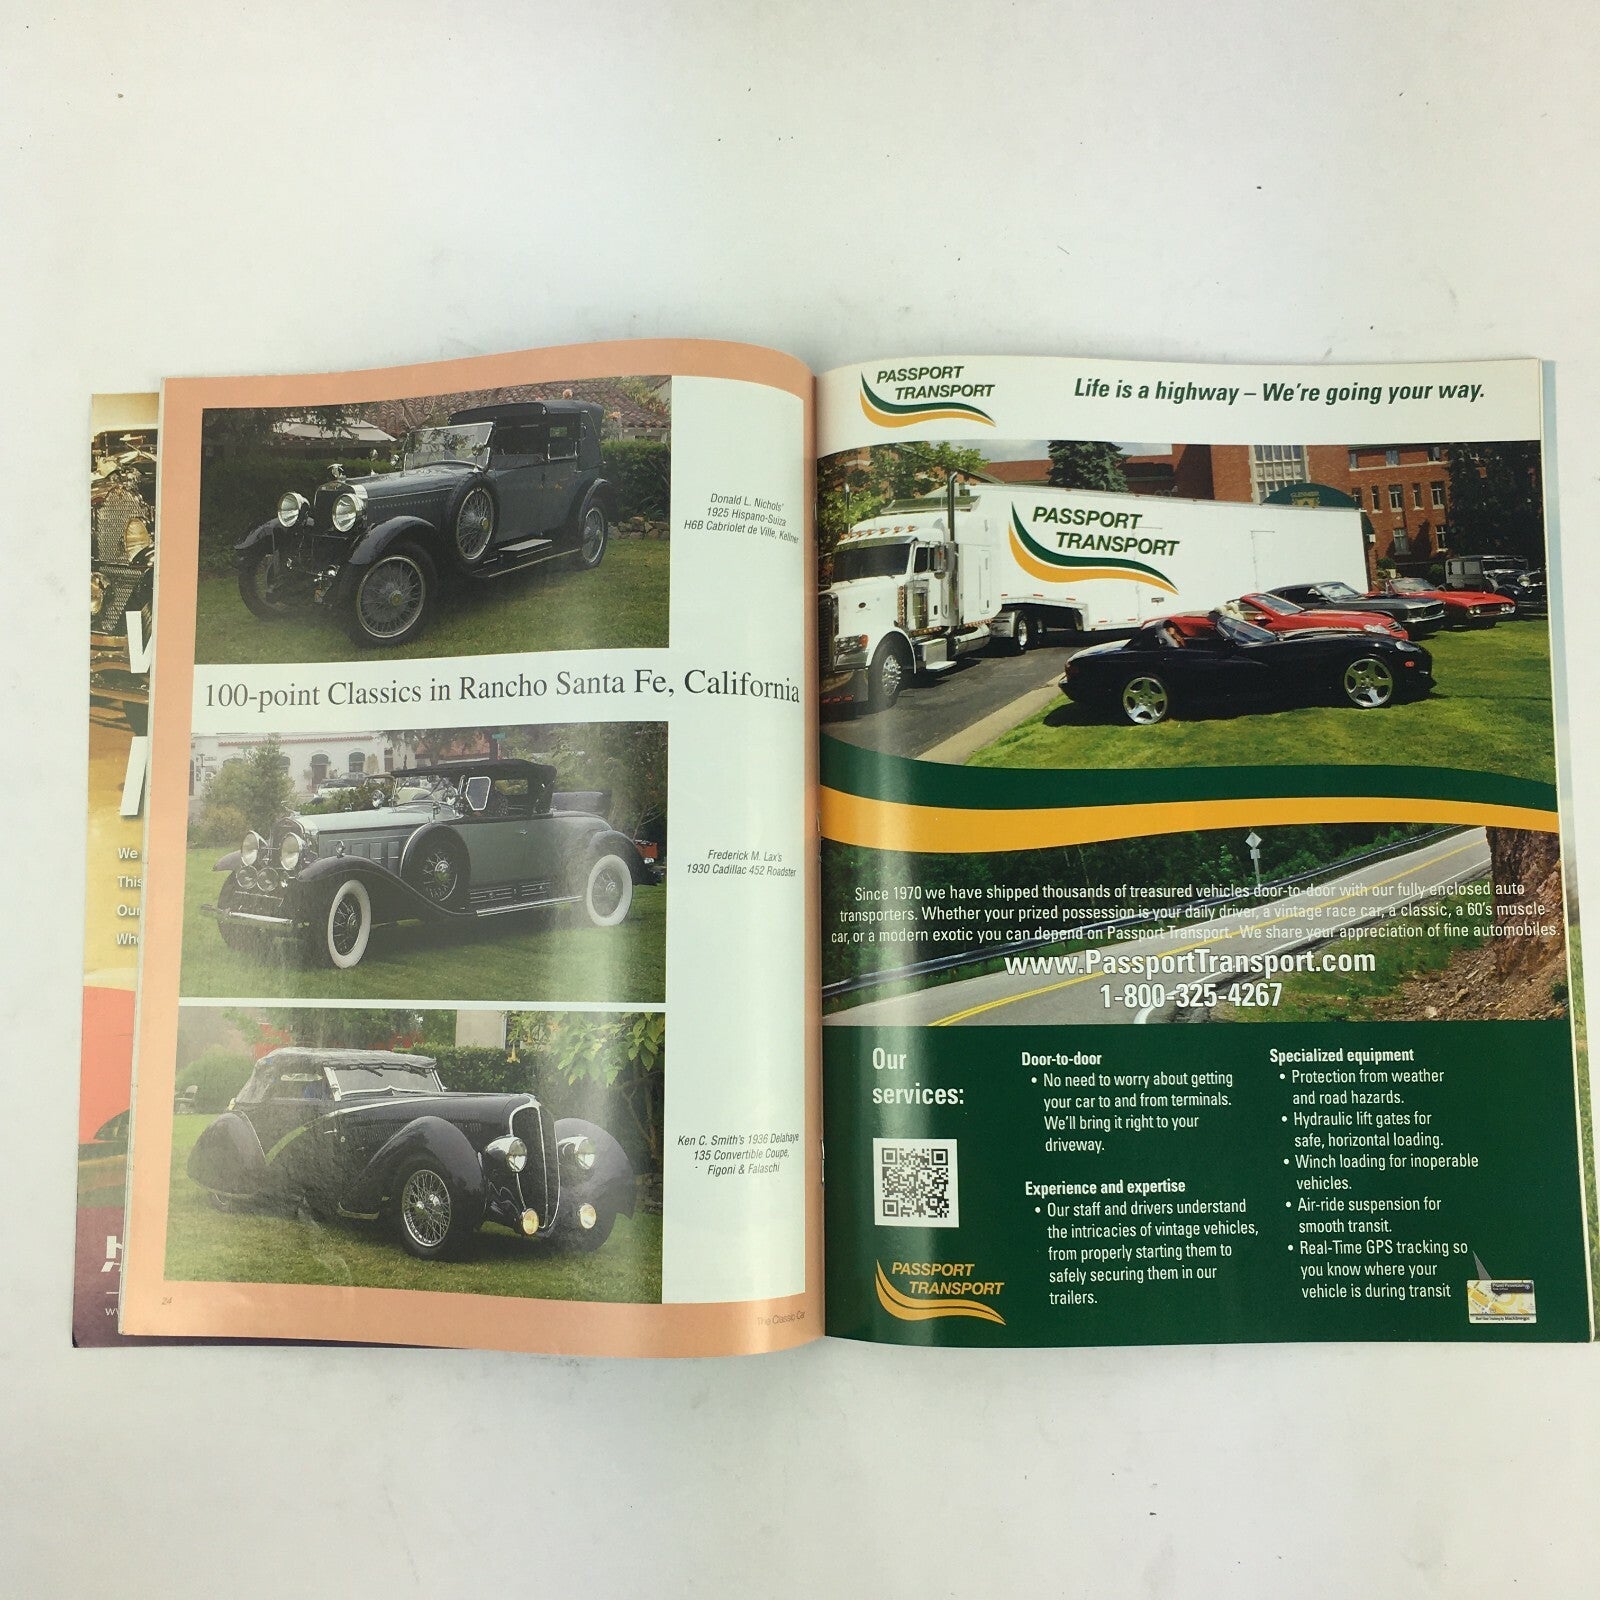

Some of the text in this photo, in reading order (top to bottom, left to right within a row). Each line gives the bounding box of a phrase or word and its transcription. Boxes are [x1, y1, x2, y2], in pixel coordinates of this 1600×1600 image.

[876, 365, 964, 384] PASSPORT
[895, 384, 995, 400] TRANSPORT
[1075, 378, 1484, 405] Life is a highway We're going your way.
[710, 493, 742, 505] Donald
[744, 496, 751, 506] L.
[707, 507, 787, 526] 1925 Hispano-Suiza
[1032, 506, 1143, 529] PASSPORT
[684, 520, 703, 529] H6B
[706, 520, 746, 533] Cabriolet
[747, 525, 757, 534] de
[1055, 531, 1180, 557] TRANSPORT
[206, 669, 800, 713] 100-point Classics in Rancho Santa Fe, California
[117, 847, 138, 859] We
[708, 850, 749, 860] Frederick
[750, 851, 761, 860] M.
[687, 863, 797, 877] 1930 Cadillac 452 Roadster
[855, 882, 1525, 901] Since 1970 we have shipped thousands of treasured vehicles door-to-door with our fully enclosed auto
[840, 902, 1545, 924] transporters. Whether your prized possession is your daily driver, a vintage race car, a classic, a 60's muscle
[831, 922, 1561, 944] car, or a modern exotic you can depend on Passport Transport. We share your appreciation of fine automobiles.
[1004, 948, 1377, 980] www.PassportTransport.com
[1100, 982, 1283, 1009] 1-800-325-4267
[872, 1047, 907, 1070] Our
[1021, 1051, 1102, 1066] Door-to-door
[1269, 1048, 1415, 1066] Specialized equipment
[1043, 1071, 1233, 1088] No need to worry about getting
[1292, 1069, 1445, 1084] Protection from weather
[872, 1083, 964, 1105] services:
[1044, 1114, 1199, 1132] We'll bring it right to your
[677, 1133, 799, 1145] Ken C. Smith's 1936 Delahaye
[1045, 1138, 1105, 1154] driveway.
[1295, 1132, 1444, 1149] safe, horizontal loading.
[694, 1150, 711, 1160] 135
[714, 1149, 763, 1160] Convertible
[707, 1162, 780, 1177] Figoni & Falaschi
[1025, 1178, 1186, 1198] Experience and expertise
[1047, 1220, 1259, 1239] the intricacies of vintage vehicles,
[1299, 1219, 1392, 1233] smooth transit.
[1300, 1240, 1468, 1256] Real-Time GPS tracking so
[891, 1262, 975, 1276] PASSPORT
[910, 1281, 1005, 1295] TRANSPORT
[1302, 1283, 1451, 1300] vehicle is during transit
[1049, 1290, 1098, 1305] trailers.
